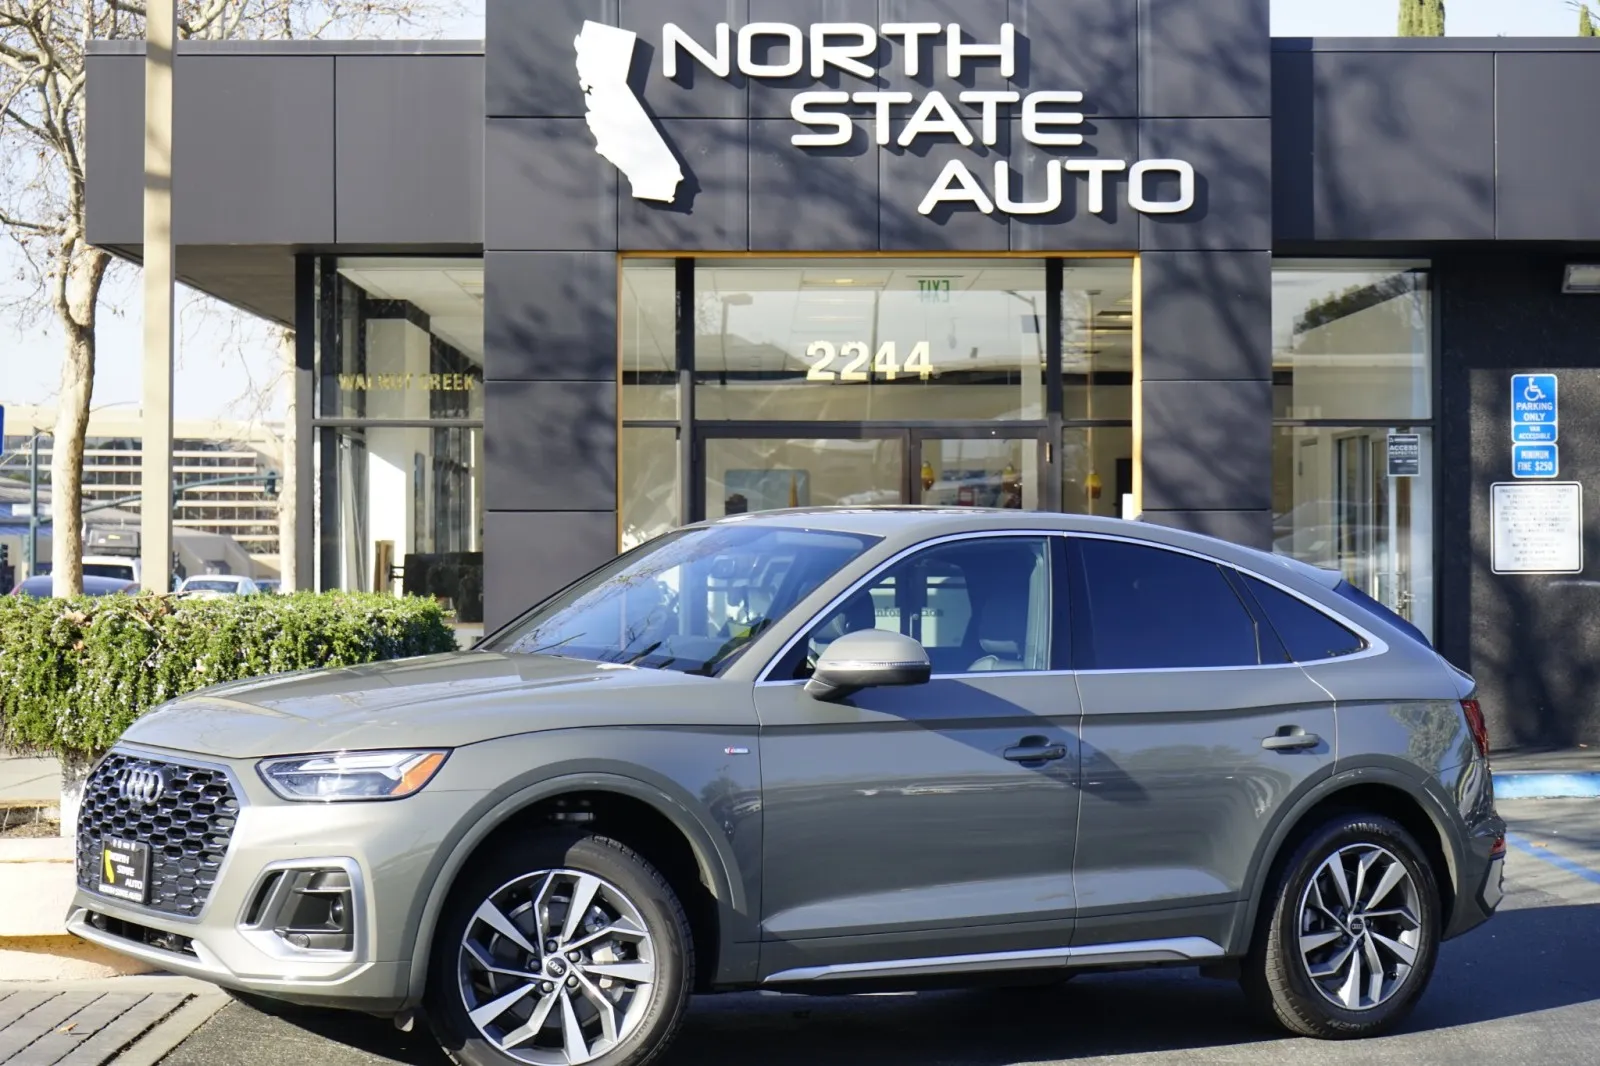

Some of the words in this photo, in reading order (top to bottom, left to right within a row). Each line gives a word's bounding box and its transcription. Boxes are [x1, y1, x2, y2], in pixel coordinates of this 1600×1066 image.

[662, 22, 1015, 78] NORTH
[790, 91, 1083, 146] STATE
[917, 159, 1195, 214] AUTO
[806, 340, 934, 381] 2244
[418, 373, 475, 391] CREEK
[1516, 402, 1553, 411] PARKING
[1523, 412, 1546, 421] ONLY
[1517, 461, 1533, 471] FINE
[1535, 461, 1553, 472] $250
[125, 878, 143, 890] AUTO
